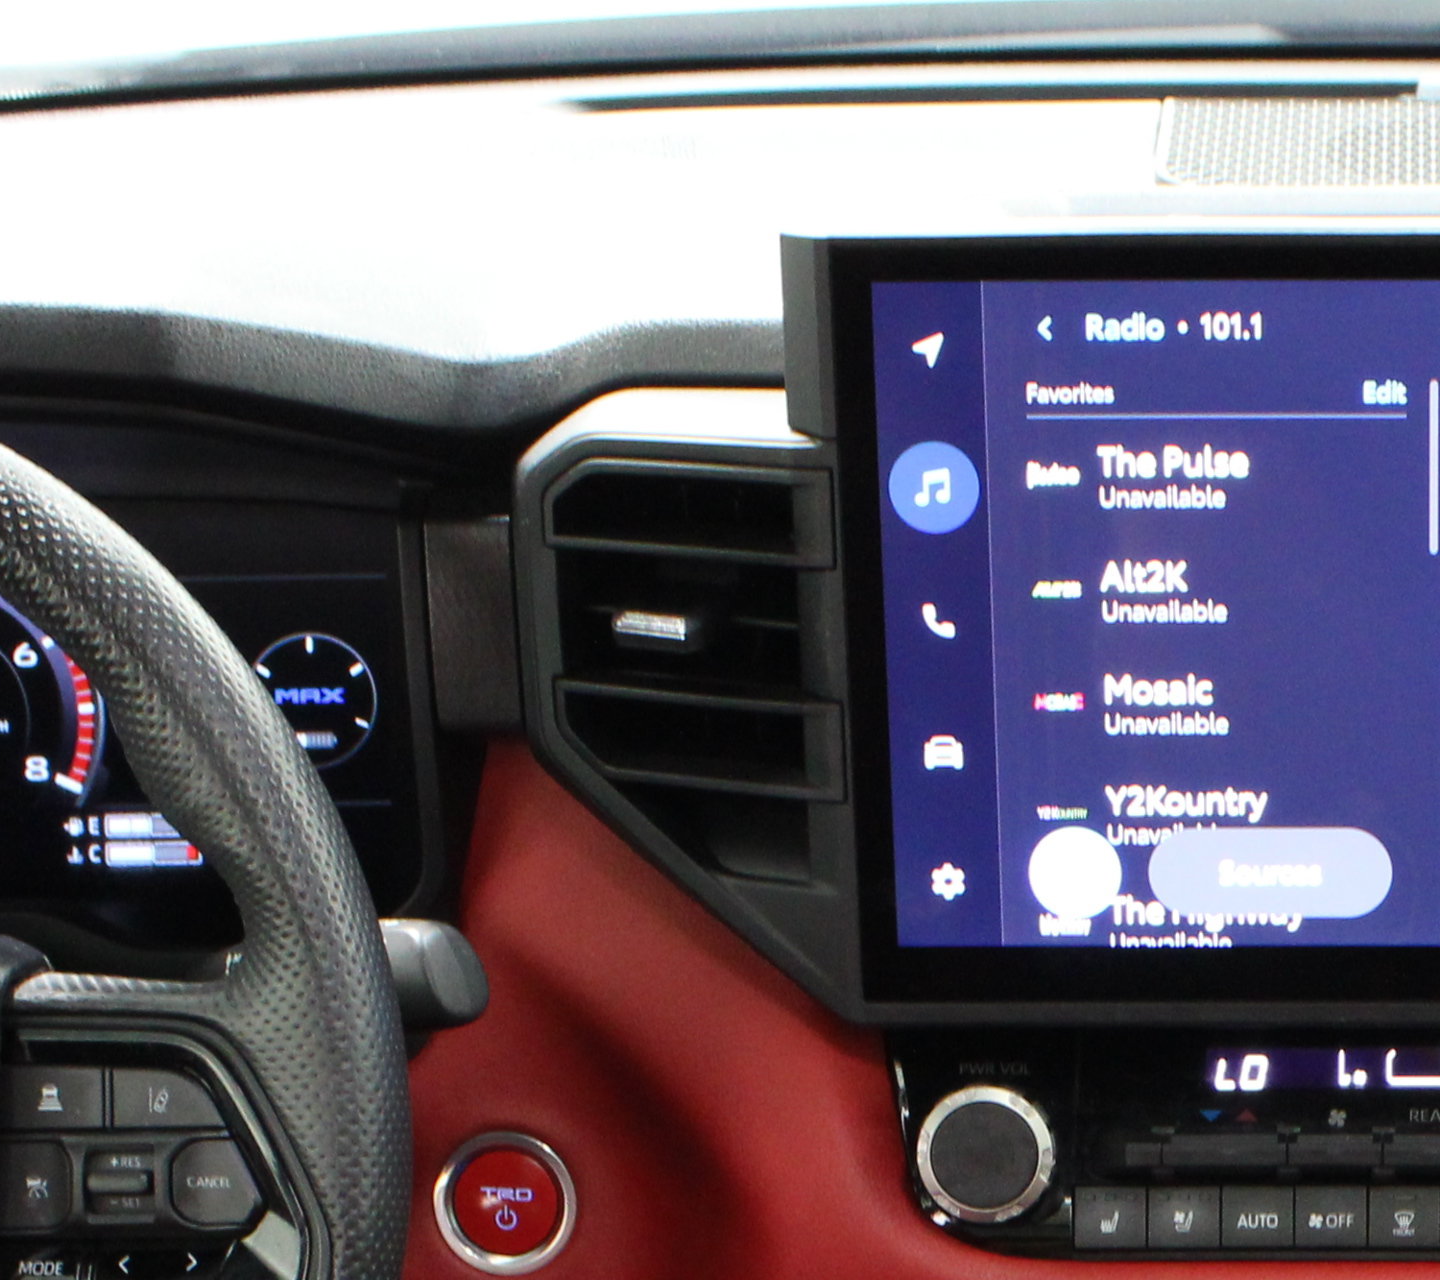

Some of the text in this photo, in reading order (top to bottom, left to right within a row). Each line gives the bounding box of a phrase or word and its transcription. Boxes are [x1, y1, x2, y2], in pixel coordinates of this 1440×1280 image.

[1085, 311, 1263, 342] Radio 101.1
[1025, 379, 1408, 405] Favorites Edit
[1096, 443, 1251, 480] The Pulse
[1098, 484, 1227, 510] Unavailable
[1099, 559, 1189, 594] Alt2K
[1101, 598, 1229, 624] Unavailable
[12, 642, 38, 668] 6
[274, 687, 345, 705] MAX
[1103, 672, 1214, 707] Mosaic
[1104, 711, 1231, 737] Unavailable
[24, 755, 50, 782] 8
[1104, 784, 1269, 824] Y2Kountry
[88, 816, 101, 836] E
[88, 844, 102, 864] C
[1217, 857, 1324, 888] Sources
[1111, 893, 1166, 927] The
[186, 1175, 231, 1189] CANCEL
[1237, 1212, 1279, 1231] AUTO
[1326, 1212, 1355, 1231] OFF
[19, 1260, 63, 1276] MODE
